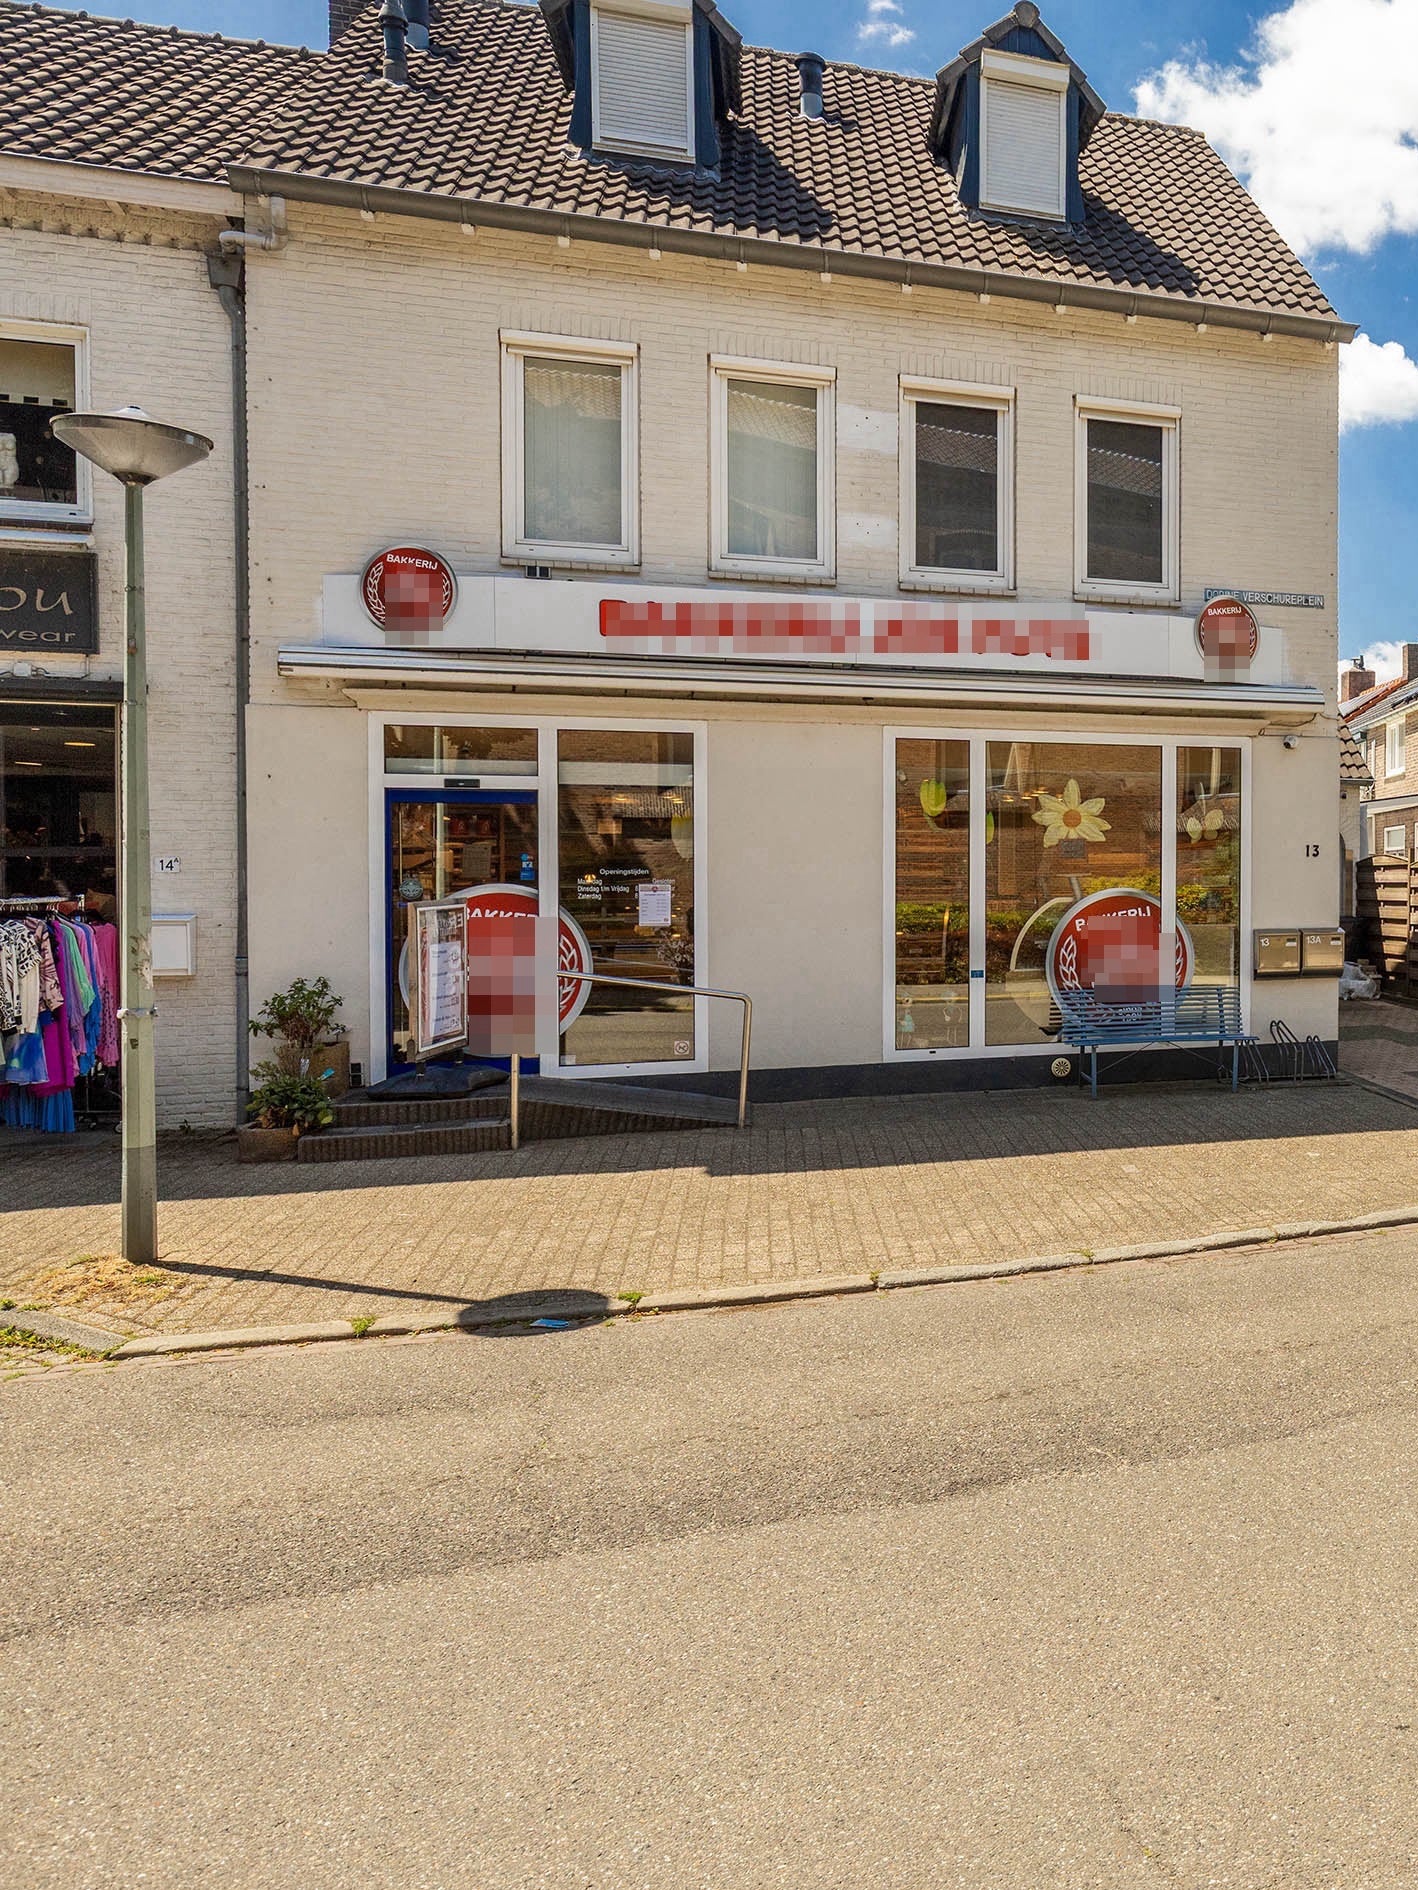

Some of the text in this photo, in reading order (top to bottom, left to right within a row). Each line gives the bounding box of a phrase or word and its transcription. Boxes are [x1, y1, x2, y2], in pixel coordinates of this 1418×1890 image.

[386, 553, 438, 570] BAKKERIJ
[1242, 591, 1324, 606] VERSCHUREPLEIN
[1207, 606, 1242, 616] BAKKERIJ
[1306, 844, 1320, 858] 13
[600, 868, 649, 876] Openingstijden
[577, 885, 600, 893] Dinsdag
[611, 885, 630, 893] Vrijdag
[577, 893, 602, 901] Zaterdag
[1260, 938, 1270, 947] 13
[1307, 935, 1322, 944] 13A
